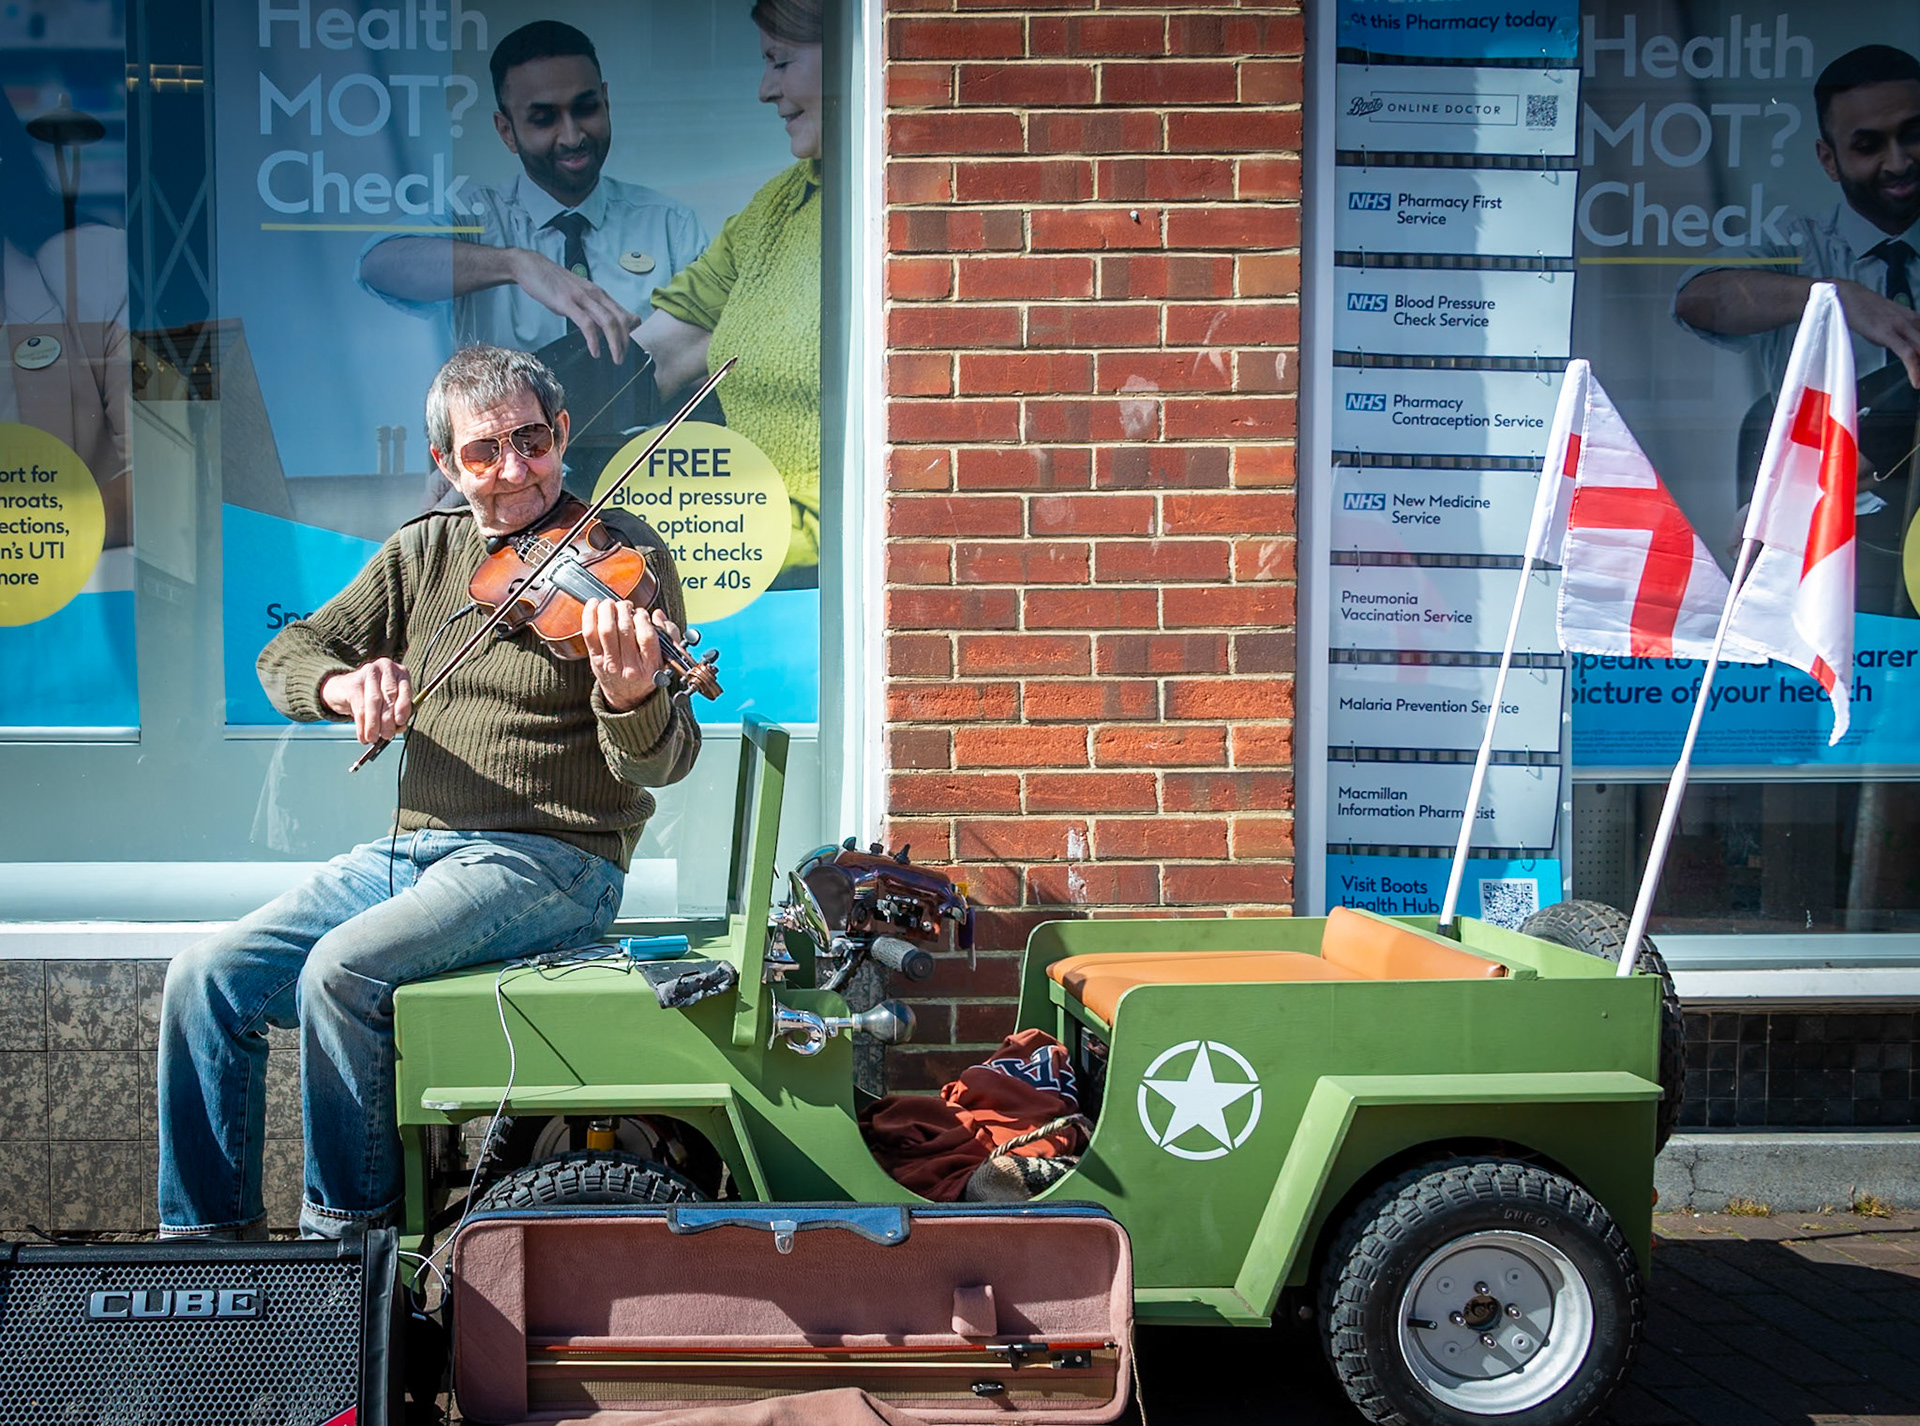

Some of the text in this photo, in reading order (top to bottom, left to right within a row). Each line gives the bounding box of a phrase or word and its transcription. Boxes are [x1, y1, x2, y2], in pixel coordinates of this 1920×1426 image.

[259, 0, 488, 51] Health
[1370, 14, 1400, 30] this
[1406, 14, 1500, 33] Pharmacy
[1505, 10, 1557, 32] today
[1583, 14, 1813, 79] Health
[259, 70, 479, 138] MOT?
[1346, 96, 1501, 117] Boots ONLINE DOCTOR
[1583, 102, 1801, 167] MOT?
[257, 150, 485, 215] Check.
[1350, 193, 1502, 212] NHS Pharmacy First
[1397, 211, 1447, 225] Service
[1577, 181, 1804, 247] Check.
[1348, 294, 1496, 311] NHS Blood Pressure
[1393, 312, 1489, 327] Check Service
[1346, 394, 1463, 412] NHS Pharmacy
[1392, 412, 1544, 430] Contraception Service
[649, 448, 731, 477] FREE
[31, 464, 58, 483] for
[612, 486, 767, 511] Blood pressure
[1344, 493, 1491, 510] NHS New Medicine
[0, 516, 70, 537] ections,
[657, 514, 744, 539] optional
[1392, 511, 1441, 525] Service
[29, 541, 64, 559] UTI
[693, 543, 763, 561] checks
[714, 570, 751, 589] 40s
[1342, 591, 1418, 605] Pneumonia
[1341, 608, 1473, 624] Vaccination Service
[1671, 677, 1701, 704] of
[1709, 686, 1771, 711] your
[1339, 698, 1519, 714] Malaria Prevention Serice
[1338, 786, 1408, 800] Macmillan
[1338, 803, 1415, 818] Information
[1341, 875, 1428, 894] Visit Boots
[1342, 895, 1440, 913] Health Hub
[89, 1288, 258, 1318] CUBE
